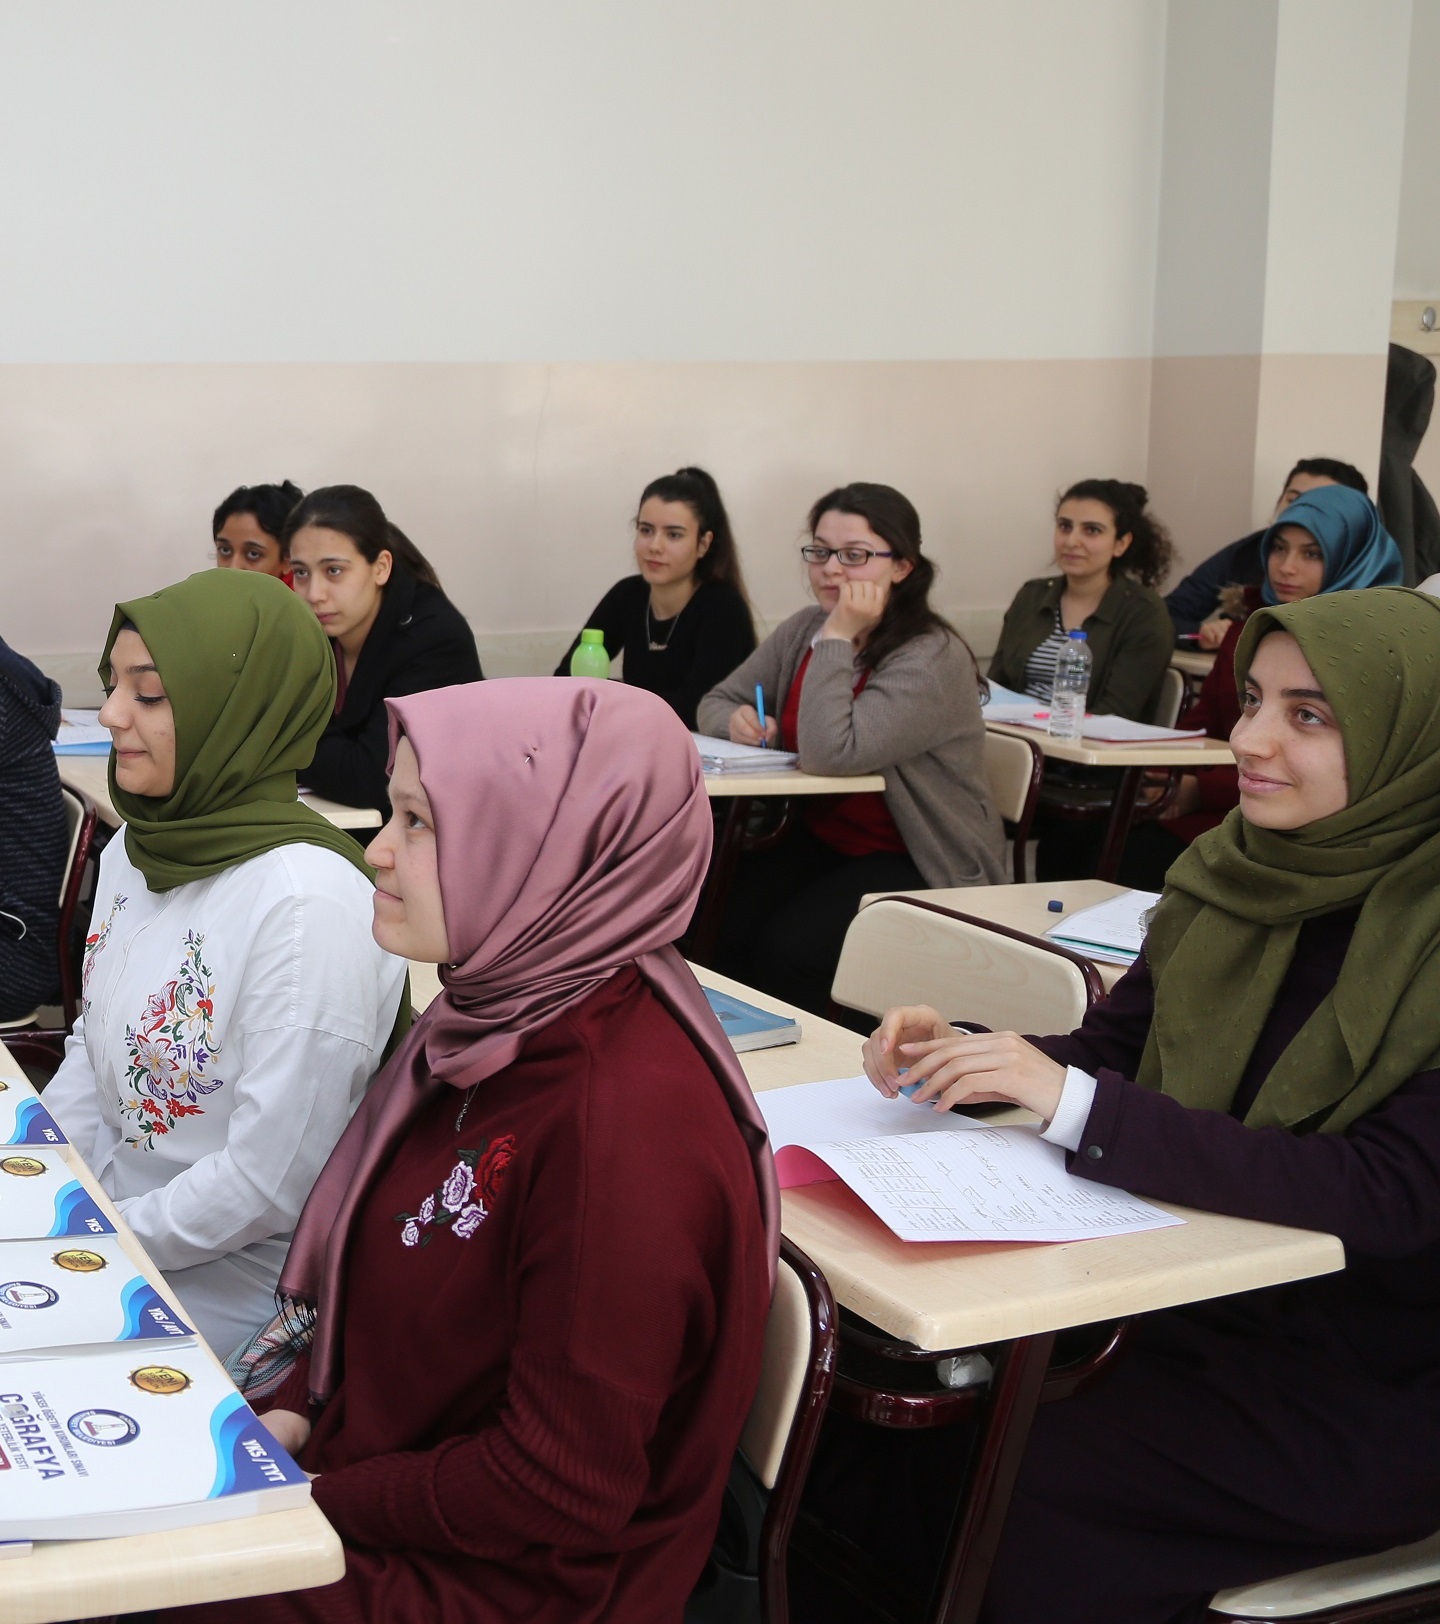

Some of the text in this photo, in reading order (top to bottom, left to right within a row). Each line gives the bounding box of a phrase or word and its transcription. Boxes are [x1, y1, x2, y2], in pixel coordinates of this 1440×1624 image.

[40, 1128, 61, 1141] YKS
[83, 1217, 105, 1232] YKS
[73, 1251, 100, 1265] YENİ
[146, 1307, 169, 1320] YKS
[160, 1323, 185, 1334] AYT
[153, 1368, 184, 1385] YENİ
[30, 1390, 91, 1477] YÜKSEK ÖĞRETİM KURUMLARI SINAVI
[11, 1453, 34, 1470] TESTİ
[239, 1439, 269, 1457] YKS
[257, 1463, 289, 1482] TYT
